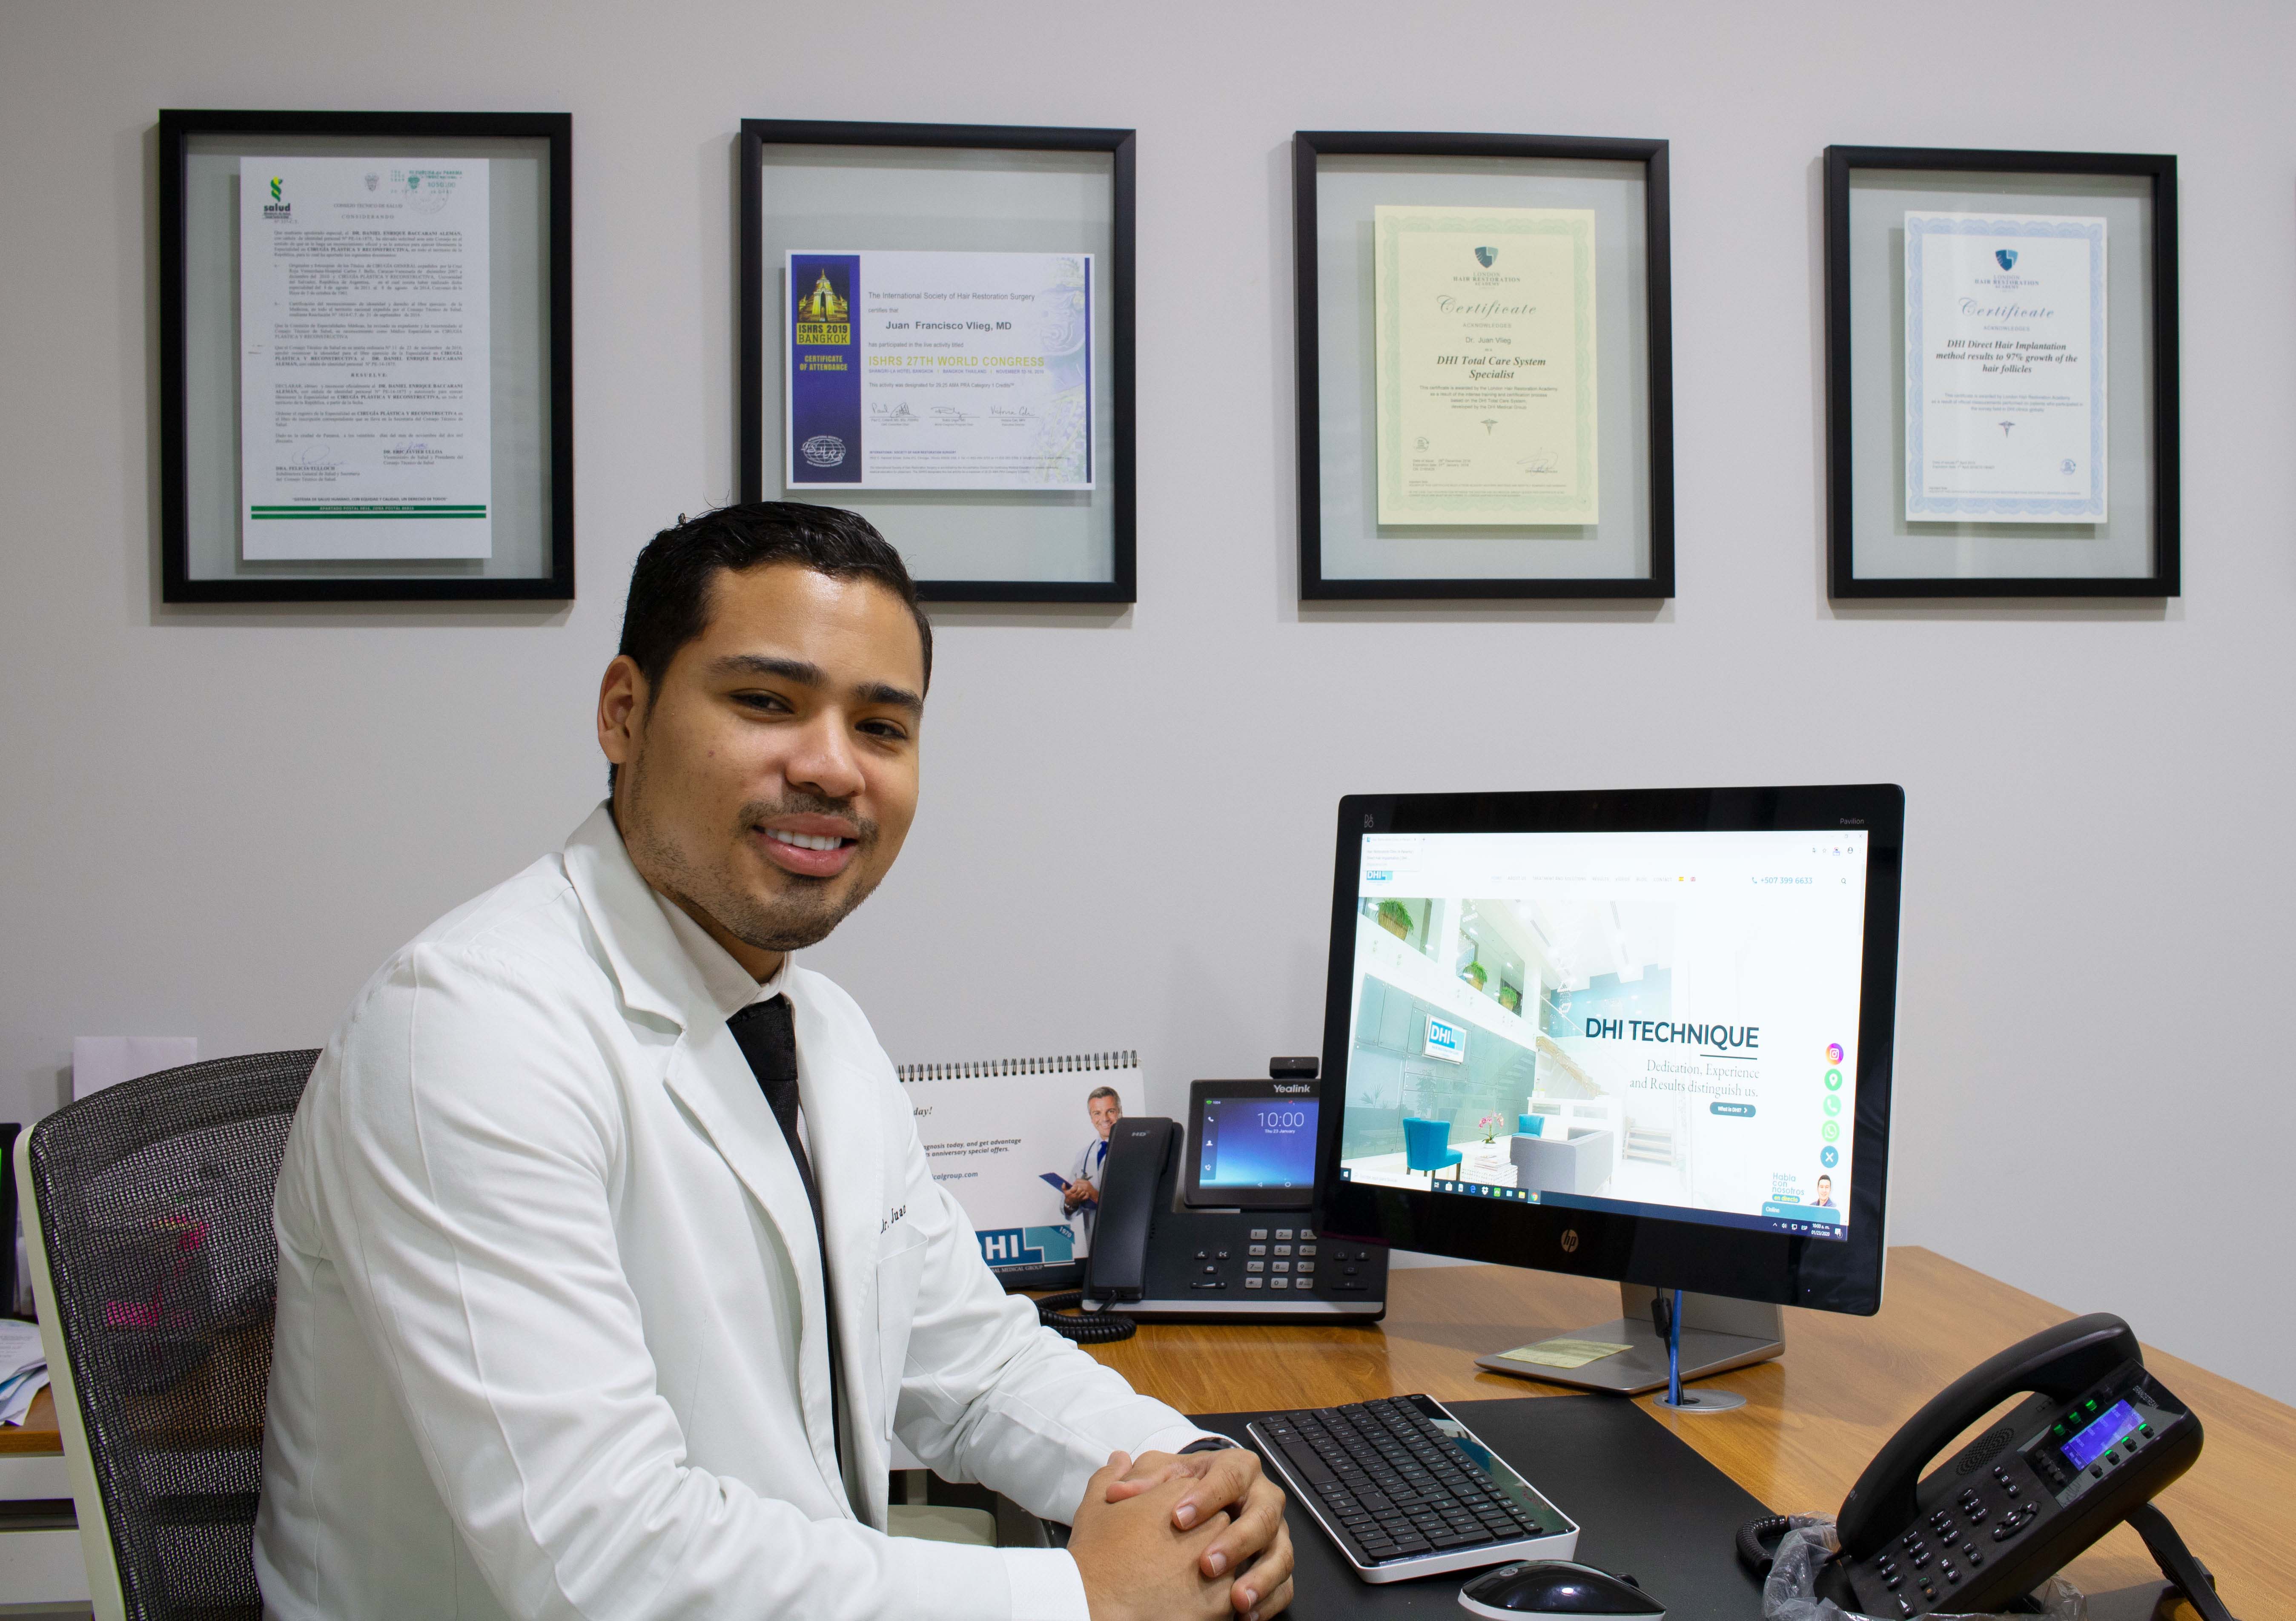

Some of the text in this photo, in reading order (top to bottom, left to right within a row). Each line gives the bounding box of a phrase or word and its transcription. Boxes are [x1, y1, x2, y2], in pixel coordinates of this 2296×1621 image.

[264, 204, 291, 212] salud
[924, 293, 947, 301] Society
[1010, 293, 1035, 301] Surgery
[1436, 295, 1536, 320] Certificate
[1958, 297, 2054, 321] Certificate
[799, 325, 847, 334] ISHRS 2019
[886, 321, 909, 330] Juan
[915, 321, 963, 330] Francisco
[966, 322, 993, 331] Vlieg,
[799, 335, 847, 343] BANGKOK
[1947, 340, 2066, 351] DHI Direct Hair Implantation
[869, 356, 1044, 367] ISHRS 27TH WORLD CONGRESS
[1437, 356, 1546, 368] DHI Total Care System
[1936, 352, 2077, 364] method results to 97% growth of the
[1982, 364, 2032, 374] hair follicles
[1469, 370, 1514, 380] Specialist
[1367, 871, 1382, 879] DHI
[1430, 1024, 1451, 1044] DHI
[1585, 1018, 1759, 1050] DHI TECHNIQUE
[1647, 1059, 1760, 1080] Dedication, Experience
[1273, 1084, 1310, 1093] Yealink
[1630, 1077, 1758, 1099] and Results distinguish us.
[913, 1106, 933, 1117] day!
[1257, 1112, 1304, 1127] 10:00
[991, 1146, 1009, 1154] offers.
[1773, 1172, 1796, 1182] Habla
[1772, 1187, 1805, 1196] nosotros
[1059, 1226, 1072, 1238] 1970
[1562, 1229, 1577, 1253] hp
[980, 1234, 1019, 1260] HI
[2133, 1385, 2160, 1410] GRANDSTREAM
